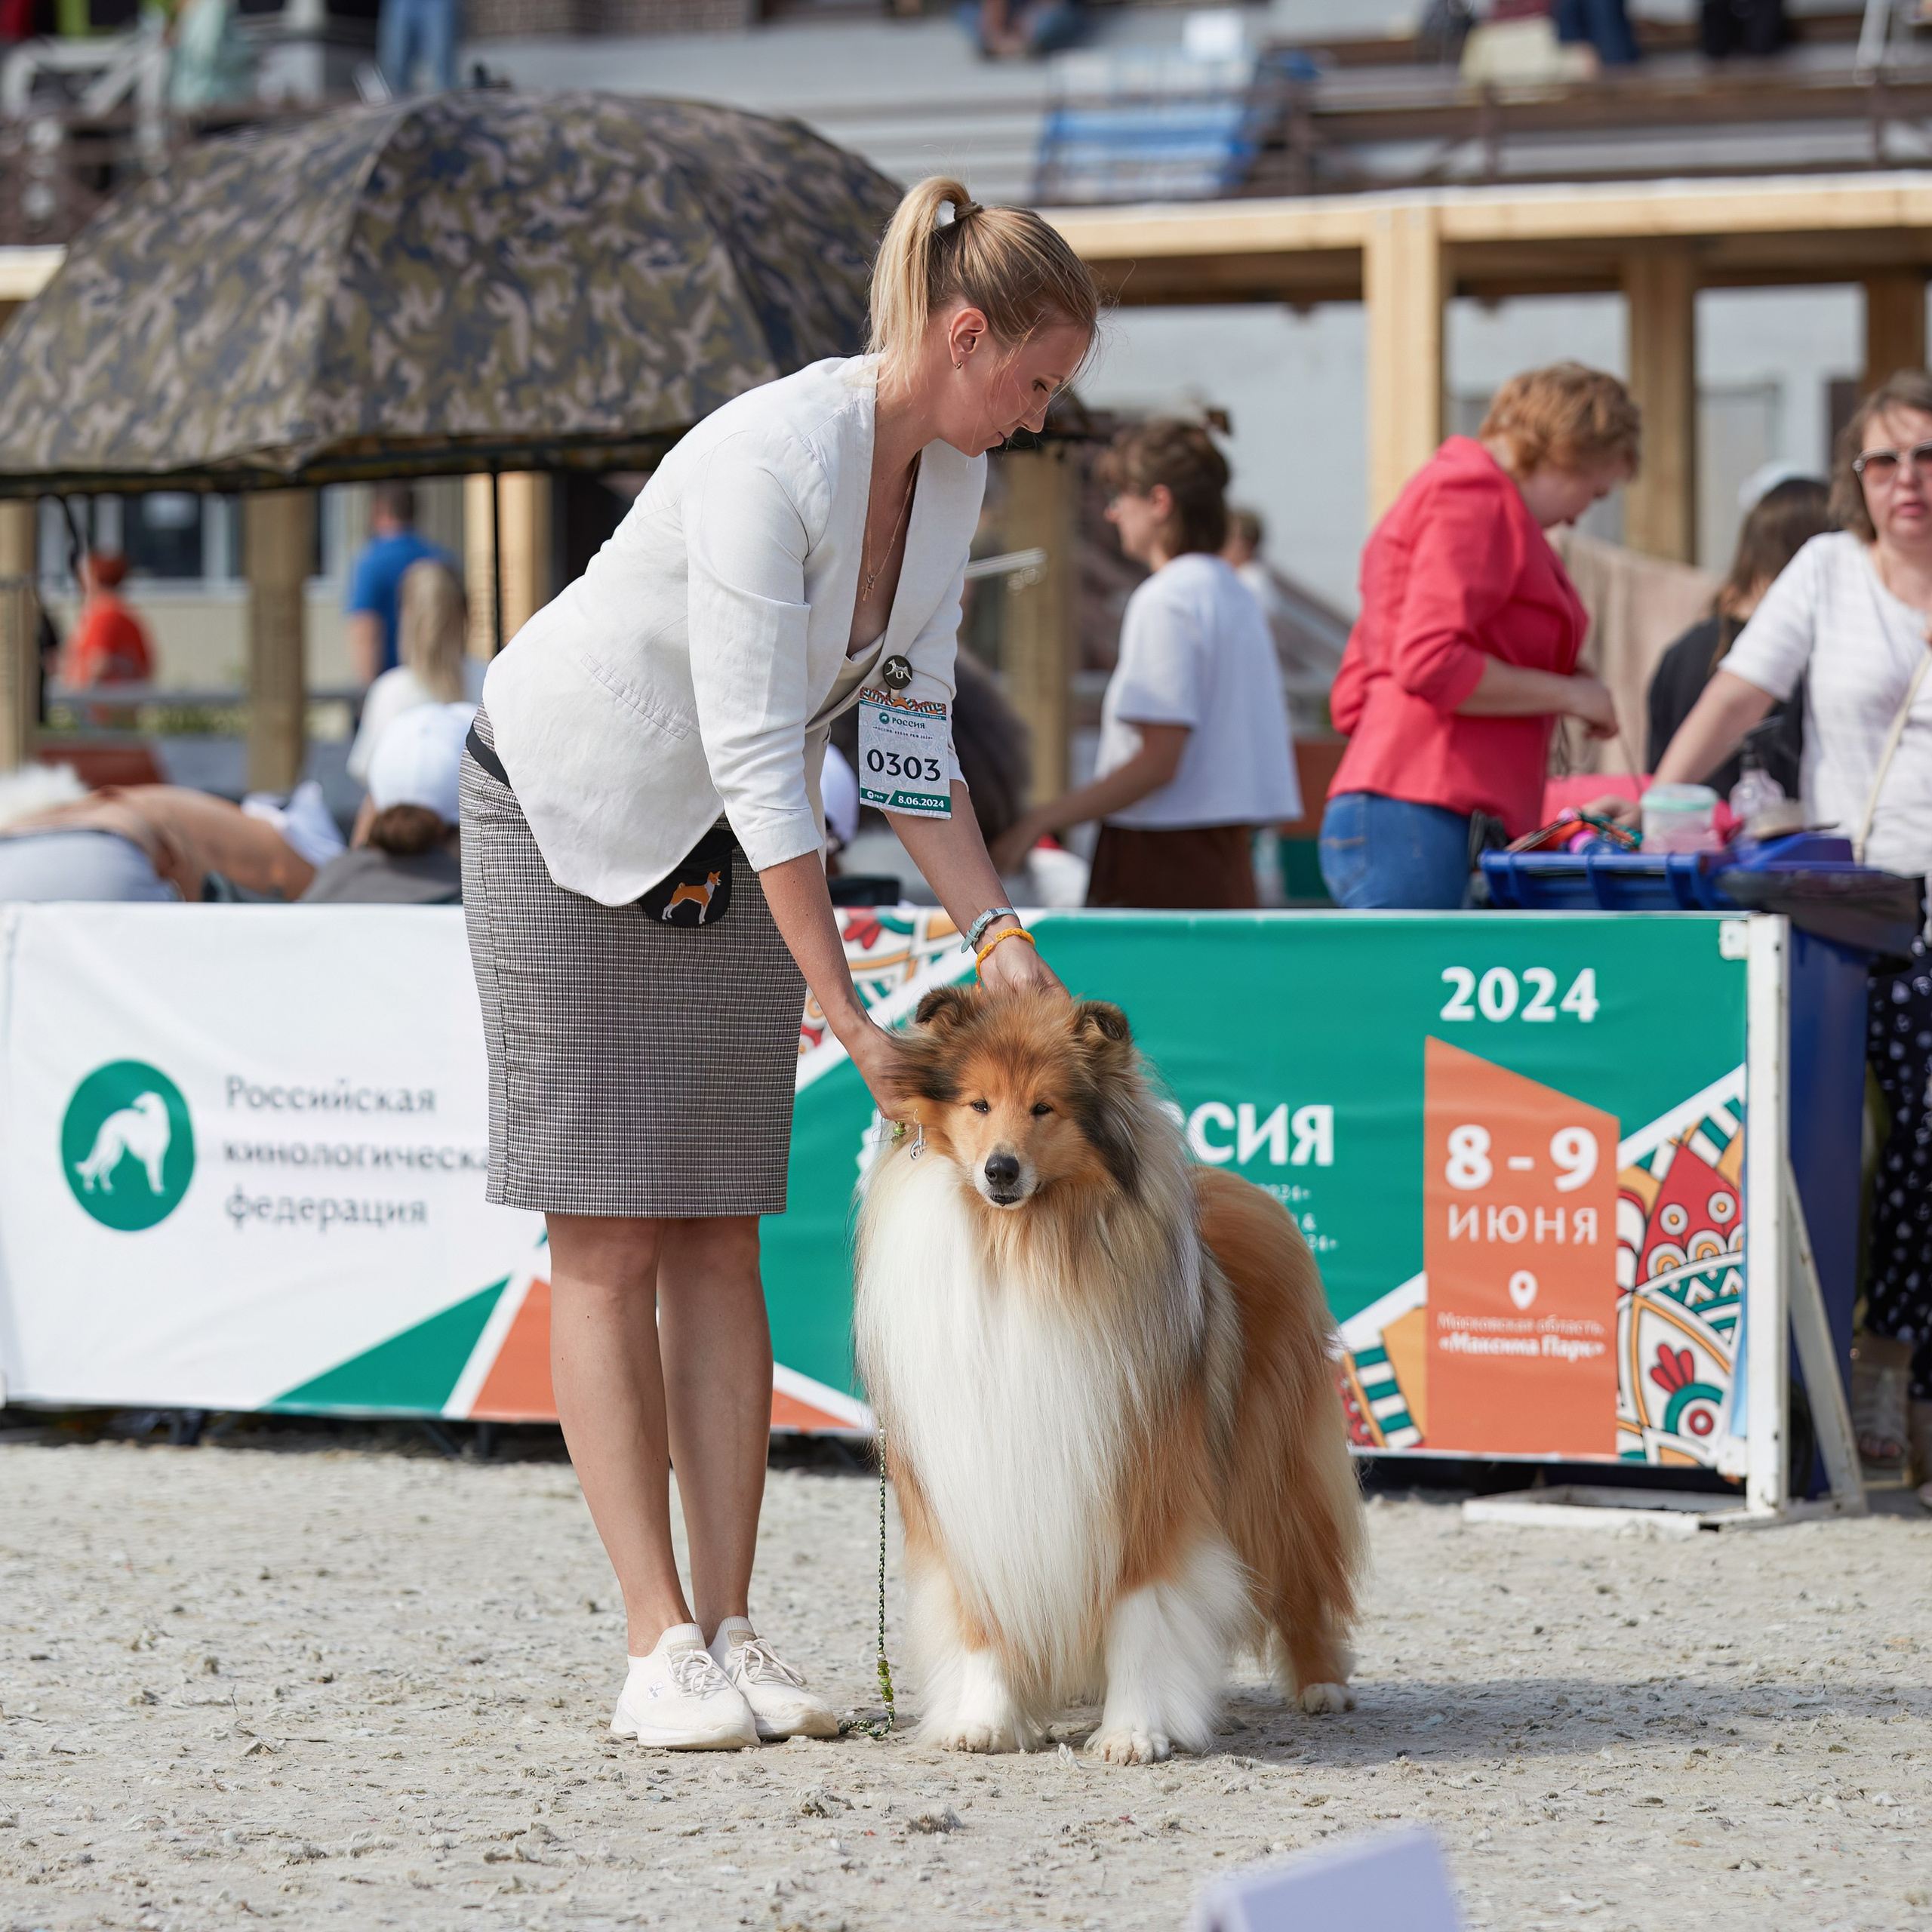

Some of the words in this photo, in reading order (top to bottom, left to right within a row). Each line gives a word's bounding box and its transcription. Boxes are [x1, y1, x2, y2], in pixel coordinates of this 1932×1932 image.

[892, 717, 925, 729] РОССИЯ
[867, 749, 941, 781] 0303
[898, 795, 945, 808] 8.06.2024
[1440, 966, 1600, 1023] 2024
[226, 1075, 436, 1113] Российская
[226, 1184, 427, 1232] федерация
[1448, 1204, 1598, 1244] ИЮНЯ
[1438, 1312, 1534, 1332] Московская
[1438, 1331, 1540, 1356] «Максима
[1542, 1334, 1606, 1362] Парк»
